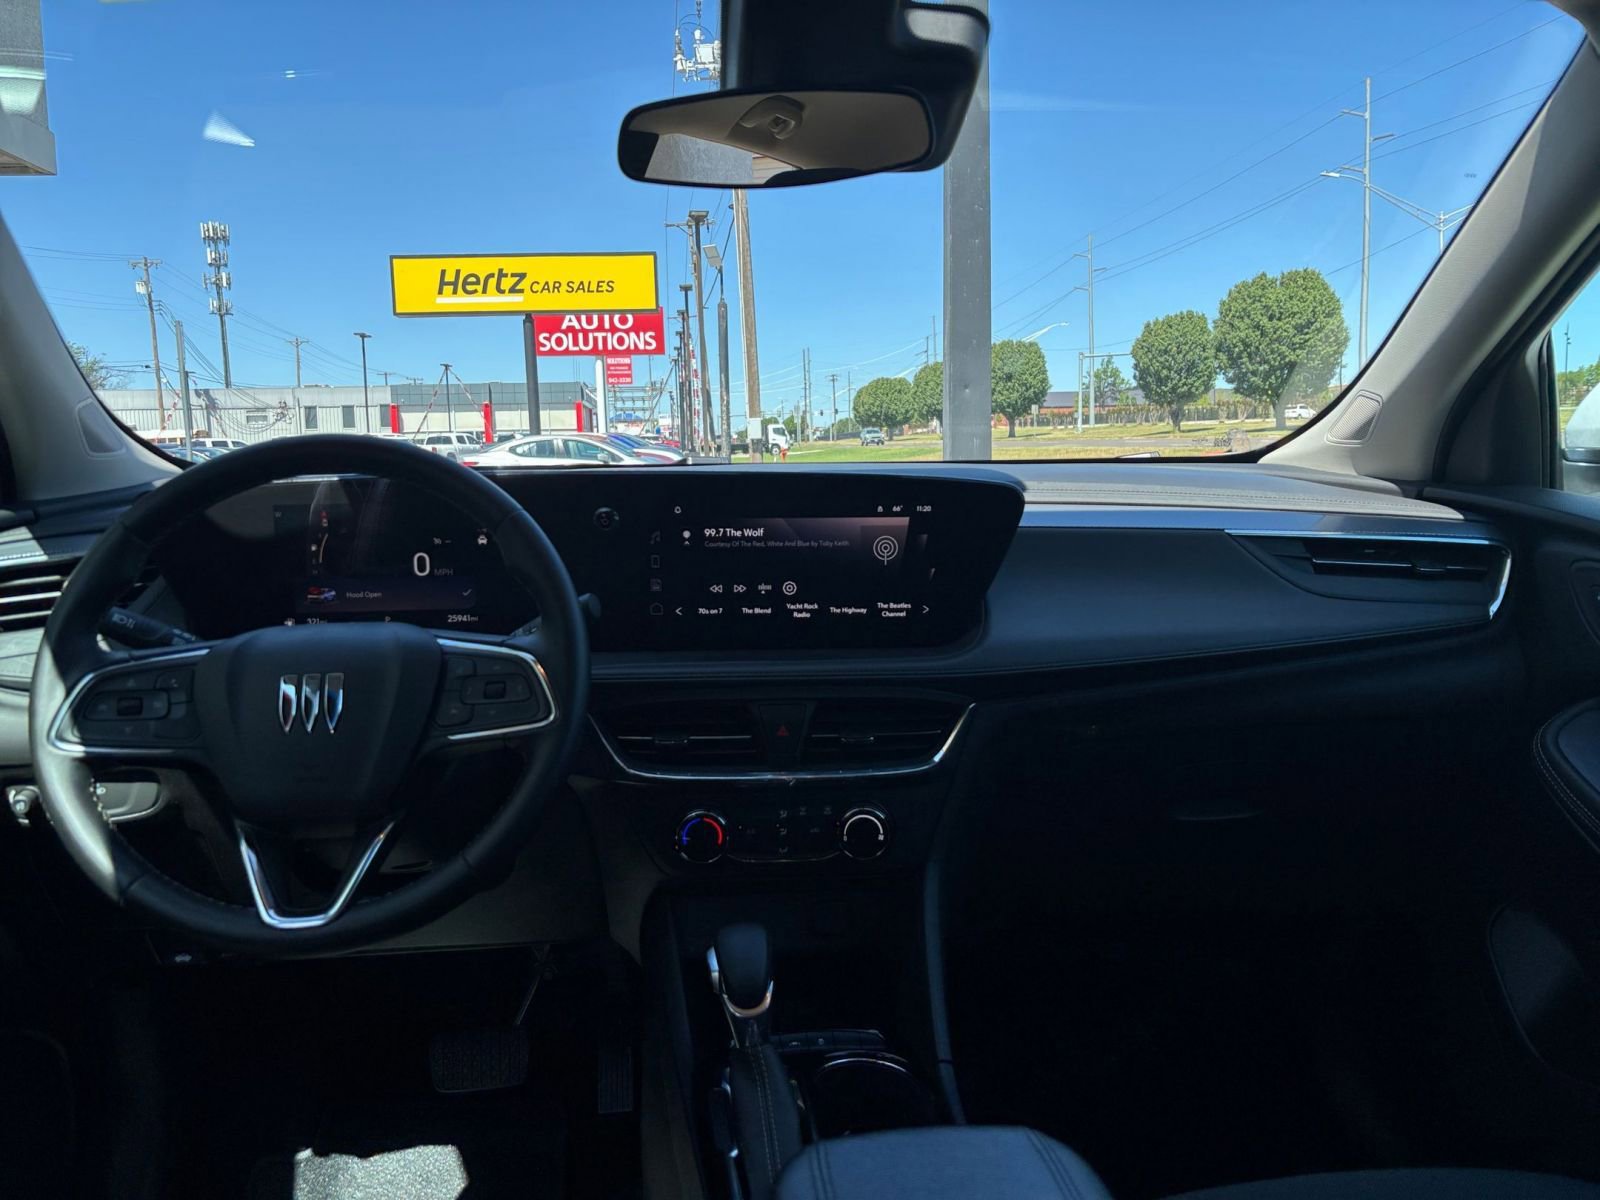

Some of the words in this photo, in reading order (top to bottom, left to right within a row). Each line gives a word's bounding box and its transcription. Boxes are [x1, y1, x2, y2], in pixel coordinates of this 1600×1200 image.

[437, 268, 527, 295] Hertz
[530, 281, 562, 294] CAR
[566, 280, 615, 293] SALES
[538, 331, 657, 351] SOLUTIONS
[704, 528, 723, 537] 99.7
[726, 528, 742, 537] The
[743, 528, 765, 537] Wolf
[767, 540, 783, 548] White
[784, 540, 795, 548] And
[797, 540, 809, 548] Blue
[819, 540, 834, 549] Toby
[413, 552, 430, 576] 0
[434, 568, 454, 576] MPH
[364, 592, 382, 600] Open
[842, 607, 868, 615] Highway
